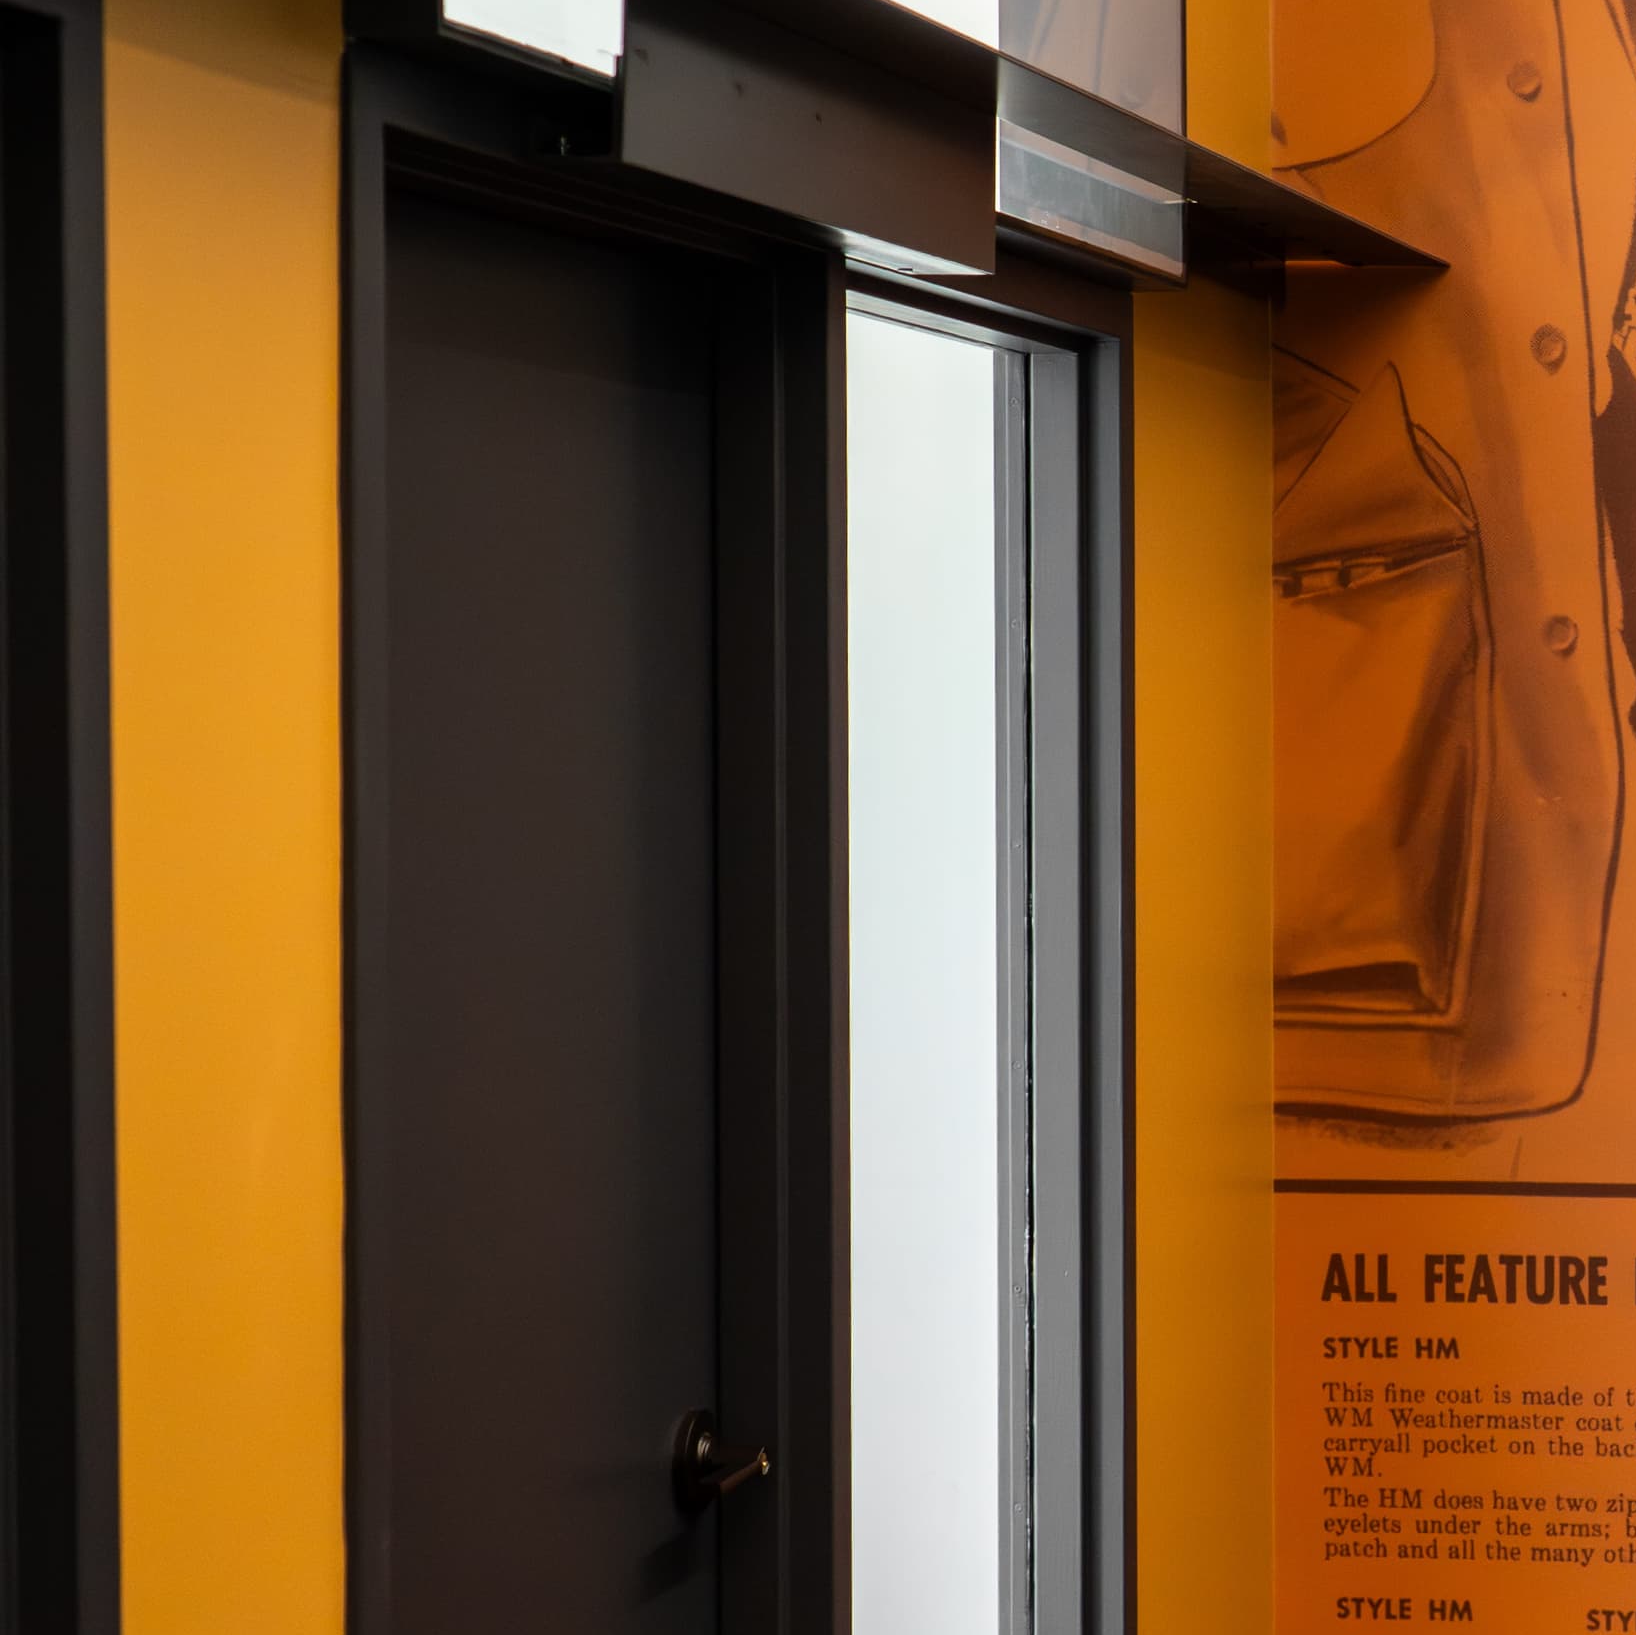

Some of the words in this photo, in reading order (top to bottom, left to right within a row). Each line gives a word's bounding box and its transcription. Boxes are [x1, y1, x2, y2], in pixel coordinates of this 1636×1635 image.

[1321, 1253, 1398, 1303] ALL
[1424, 1253, 1608, 1306] FEATURE
[1323, 1336, 1399, 1359] STYLE
[1415, 1337, 1460, 1360] HM
[1322, 1381, 1374, 1403] This
[1384, 1382, 1425, 1404] fine
[1435, 1387, 1482, 1404] coat
[1494, 1384, 1511, 1404] is
[1522, 1385, 1583, 1406] made
[1594, 1387, 1615, 1407] of
[1324, 1407, 1373, 1427] WM
[1388, 1407, 1564, 1430] Weathermaster
[1576, 1415, 1624, 1432] coat
[1323, 1432, 1411, 1456] carryall
[1423, 1433, 1497, 1458] pocket
[1508, 1440, 1535, 1455] on
[1548, 1435, 1584, 1456] the
[1324, 1456, 1382, 1477] WM.
[1323, 1486, 1369, 1508] The
[1378, 1487, 1422, 1509] HM
[1433, 1489, 1484, 1510] does
[1492, 1490, 1546, 1512] have
[1555, 1494, 1597, 1512] two
[1323, 1512, 1401, 1537] eyelets
[1415, 1514, 1481, 1535] under
[1495, 1514, 1532, 1537] the
[1545, 1522, 1610, 1540] arms;
[1325, 1537, 1388, 1561] patch
[1397, 1538, 1438, 1559] and
[1448, 1538, 1475, 1560] all
[1486, 1539, 1521, 1561] the
[1530, 1547, 1595, 1567] many
[1336, 1597, 1412, 1621] STYLE
[1428, 1598, 1473, 1622] HM
